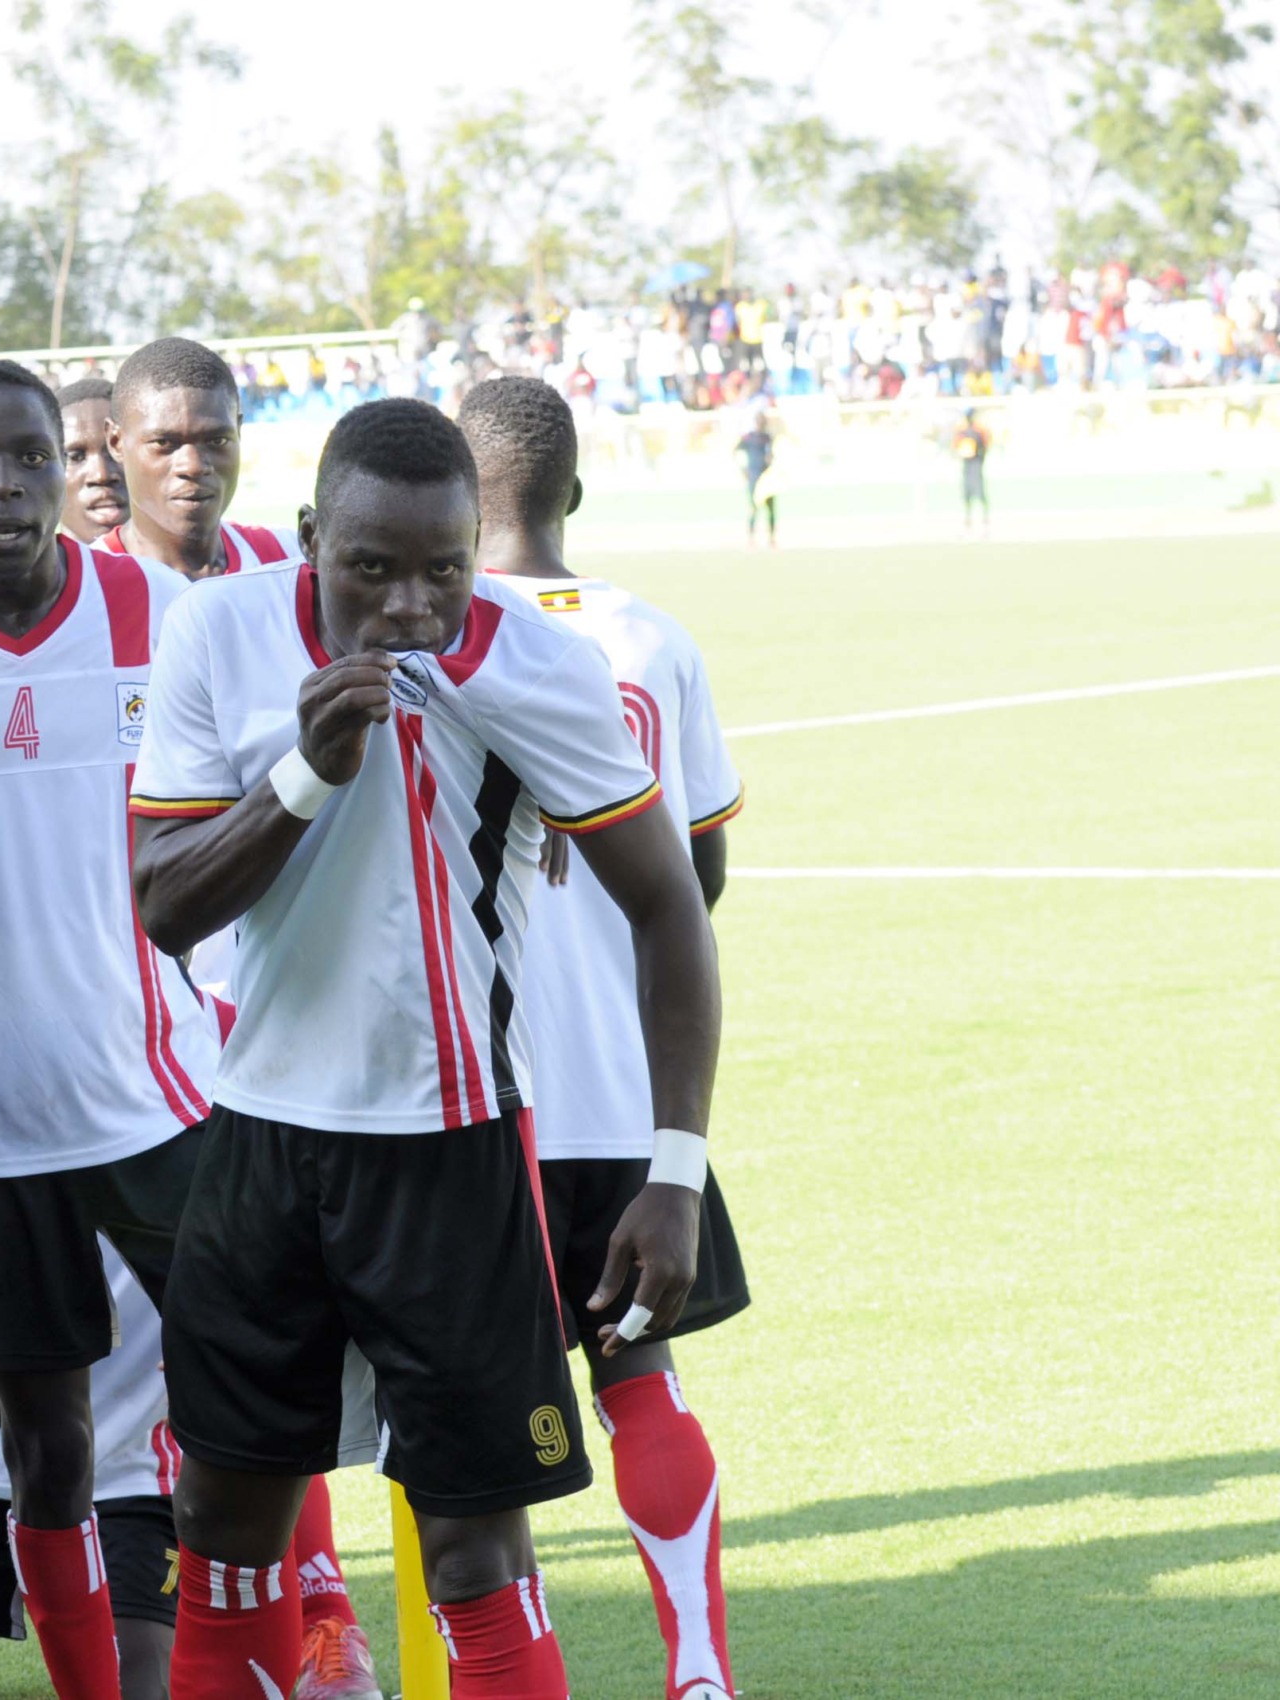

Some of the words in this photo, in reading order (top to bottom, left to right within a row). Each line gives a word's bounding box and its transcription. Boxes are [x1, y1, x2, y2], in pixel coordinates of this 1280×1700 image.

[4, 686, 39, 760] 4
[529, 1405, 569, 1466] 9
[299, 1577, 348, 1598] didas
